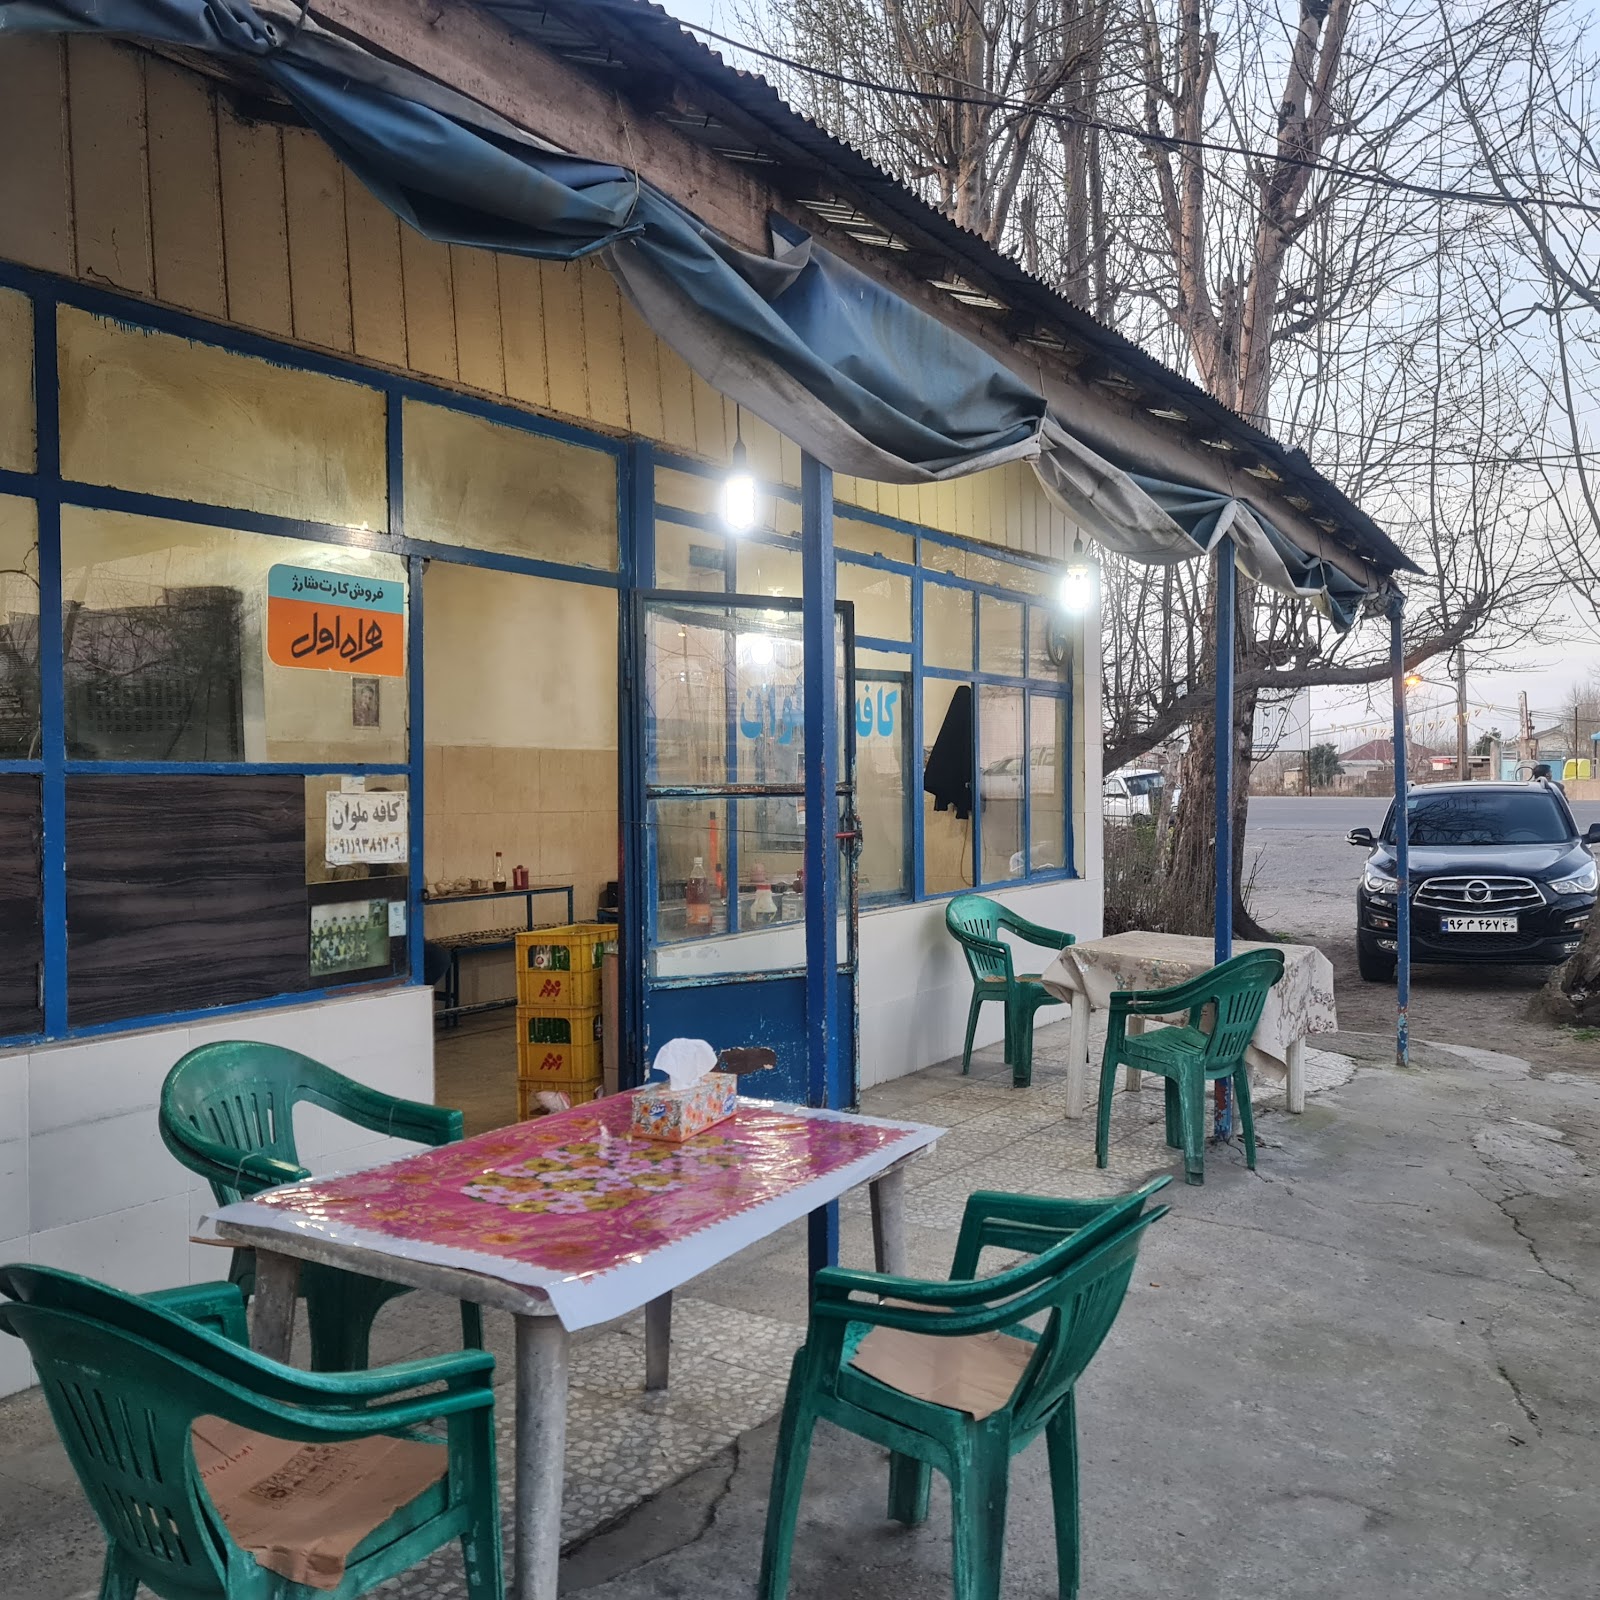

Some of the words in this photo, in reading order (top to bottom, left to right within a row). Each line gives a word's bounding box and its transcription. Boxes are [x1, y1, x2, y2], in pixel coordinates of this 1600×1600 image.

[292, 574, 319, 592] شارژ
[319, 579, 350, 597] کارت
[349, 583, 384, 602] فروش
[291, 612, 341, 659] اول
[332, 800, 369, 831] ملوان
[373, 800, 400, 823] کافه
